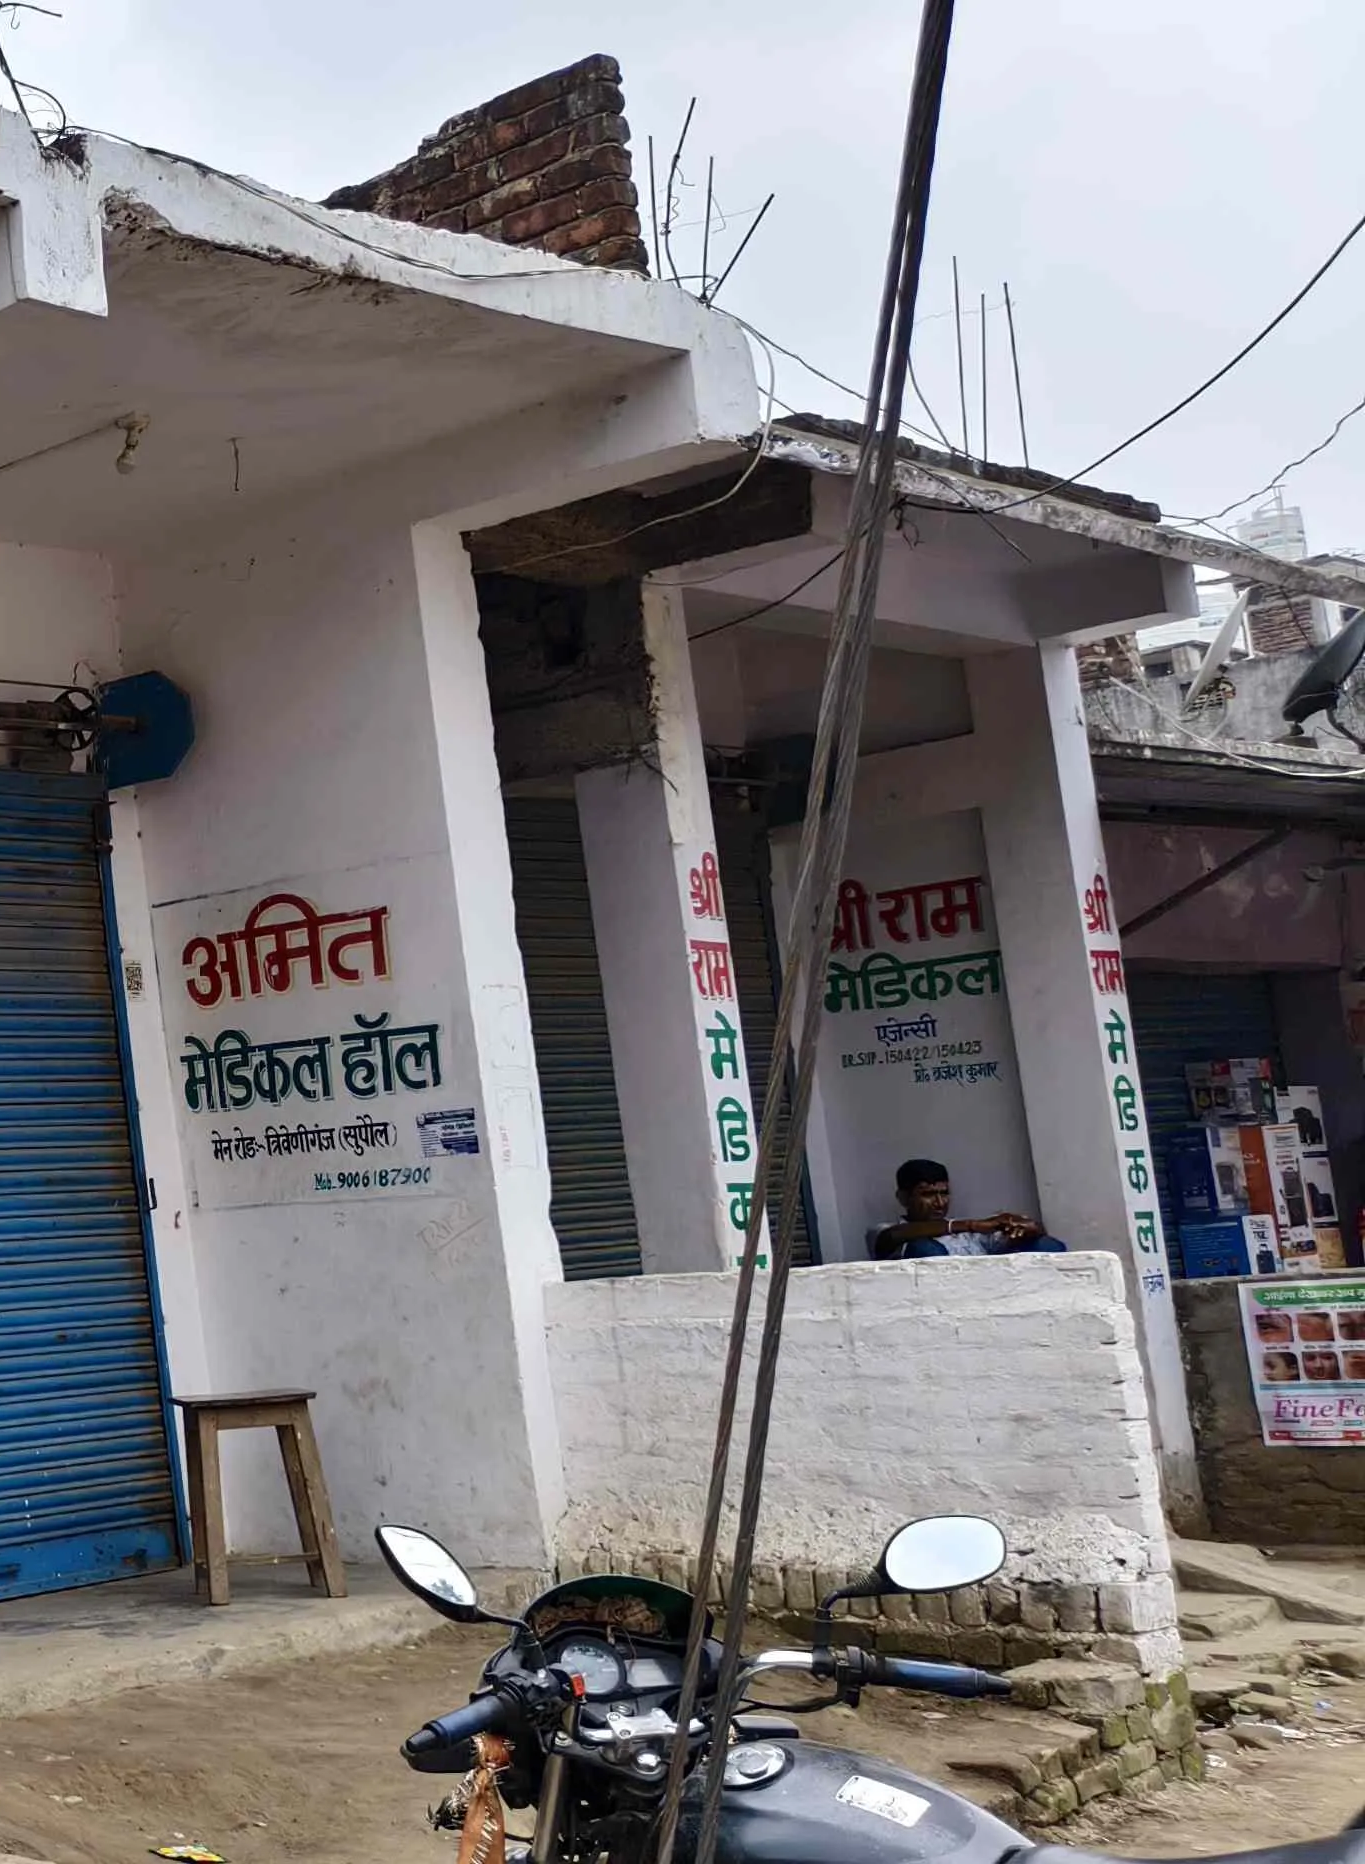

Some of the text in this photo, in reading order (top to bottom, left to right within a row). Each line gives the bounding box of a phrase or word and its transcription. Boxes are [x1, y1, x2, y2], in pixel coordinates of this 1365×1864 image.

[690, 851, 725, 922] श्री
[875, 875, 986, 944] राम
[1085, 873, 1114, 936] श्री
[181, 893, 390, 1009] अमित
[690, 939, 734, 1002] राम
[824, 950, 1002, 1014] मेडिकल
[1090, 950, 1125, 997] राम
[180, 1011, 442, 1113] मेडिकल हॉल
[211, 1130, 233, 1163] मेन
[265, 1123, 336, 1157] त्रिवेणीगंज
